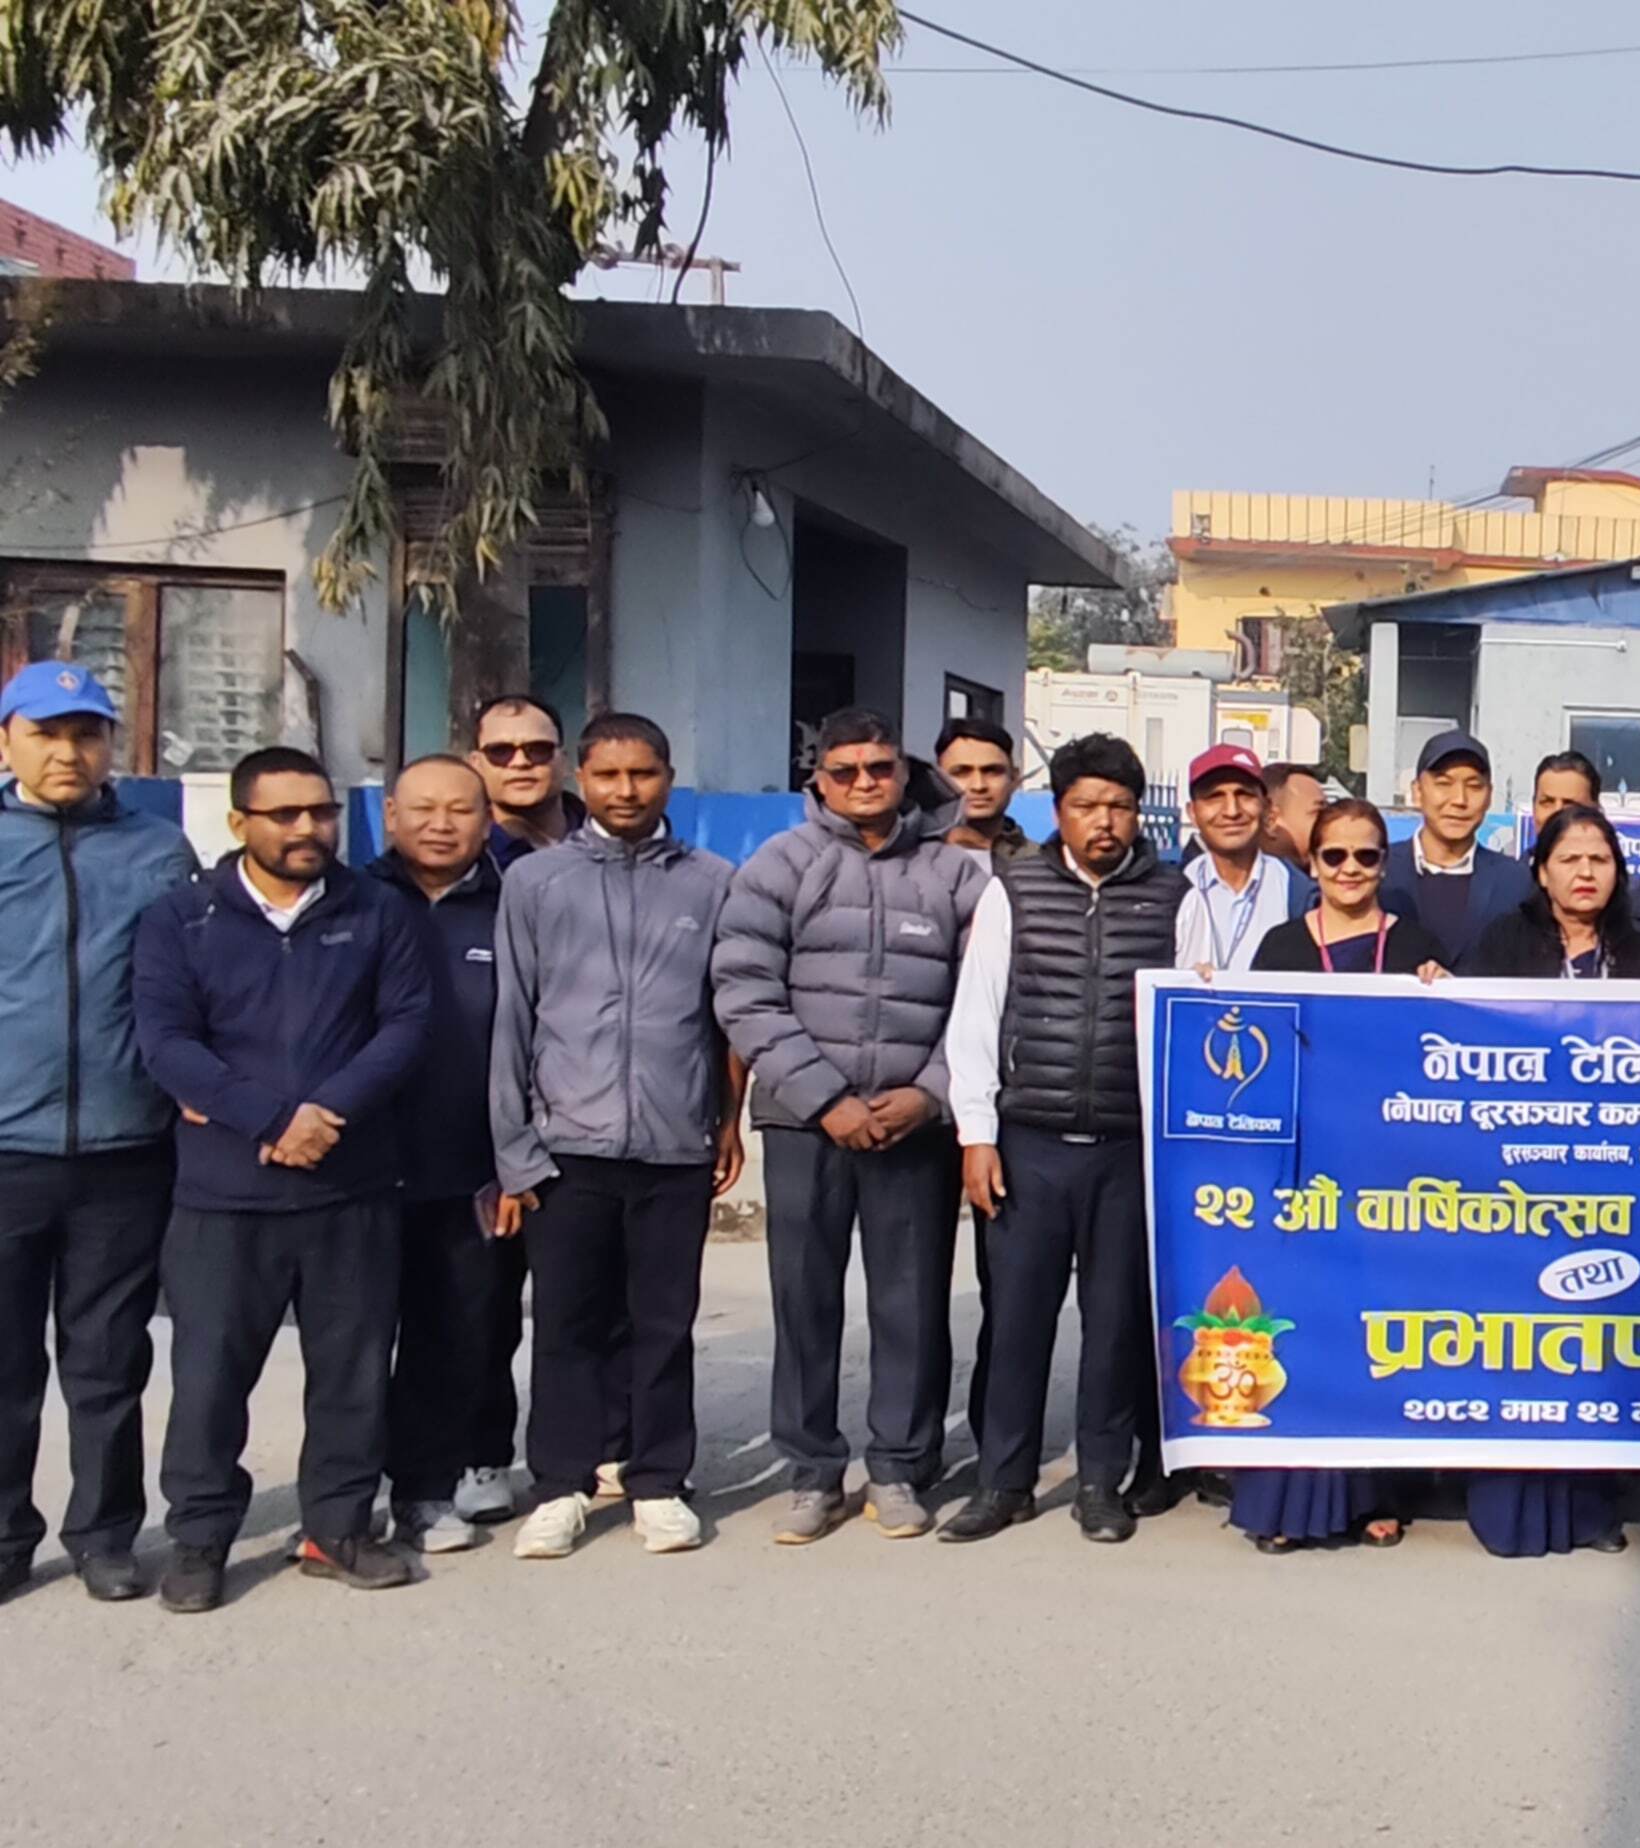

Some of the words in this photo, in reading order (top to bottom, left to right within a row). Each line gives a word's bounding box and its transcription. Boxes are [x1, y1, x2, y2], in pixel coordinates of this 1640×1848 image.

[1419, 1032, 1551, 1083] नेपाल
[1185, 1109, 1225, 1130] नेपाल
[1226, 1111, 1282, 1133] टेलिकम
[1382, 1091, 1465, 1124] (नेपाल
[1469, 1100, 1594, 1131] दूरसञ्चार
[1193, 1183, 1255, 1229] २२
[1356, 1175, 1637, 1240] वार्षिकोत्सव
[1555, 1255, 1626, 1295] तथा
[1402, 1398, 1491, 1423] २०८२
[1500, 1398, 1569, 1424] माघ
[1577, 1400, 1620, 1425] २२
